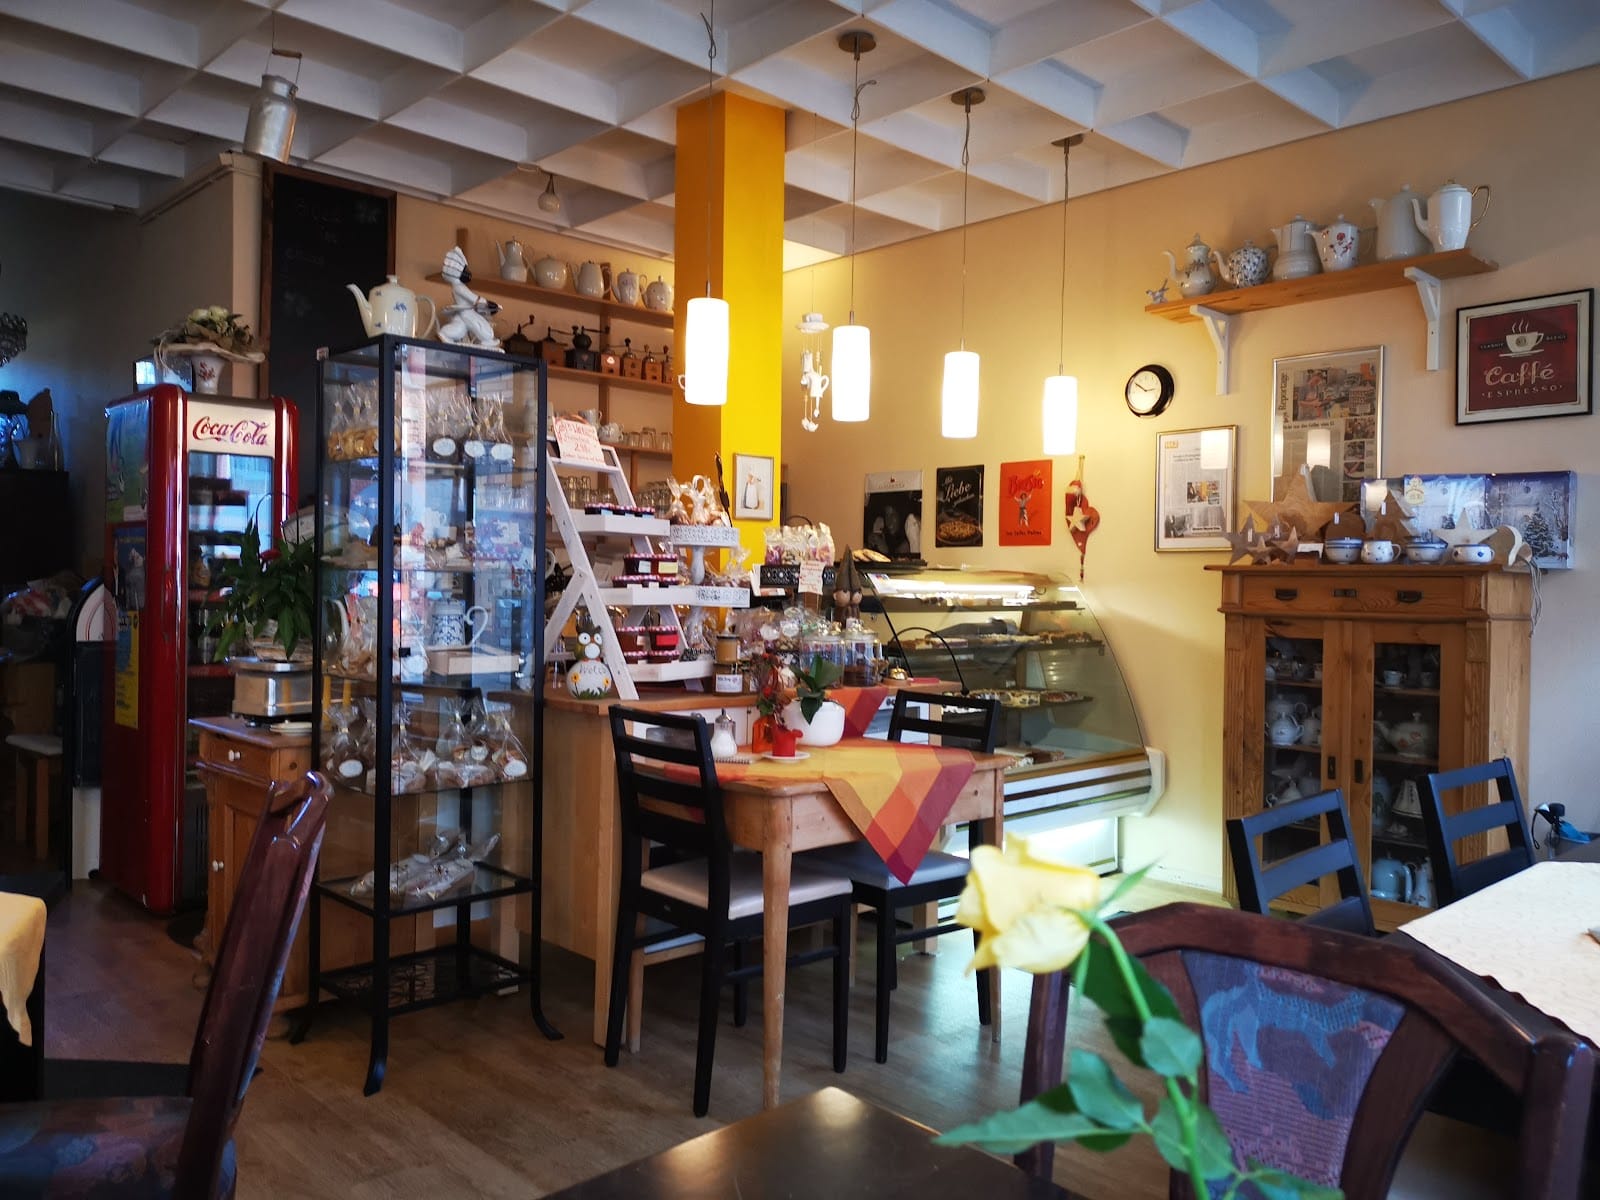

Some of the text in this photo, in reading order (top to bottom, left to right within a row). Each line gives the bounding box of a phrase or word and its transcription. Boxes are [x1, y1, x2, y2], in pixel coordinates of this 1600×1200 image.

[1484, 360, 1556, 387] Caffé
[1487, 384, 1558, 400] ESPRESSO
[192, 415, 269, 446] Coca-Cola
[946, 480, 971, 503] Liebe
